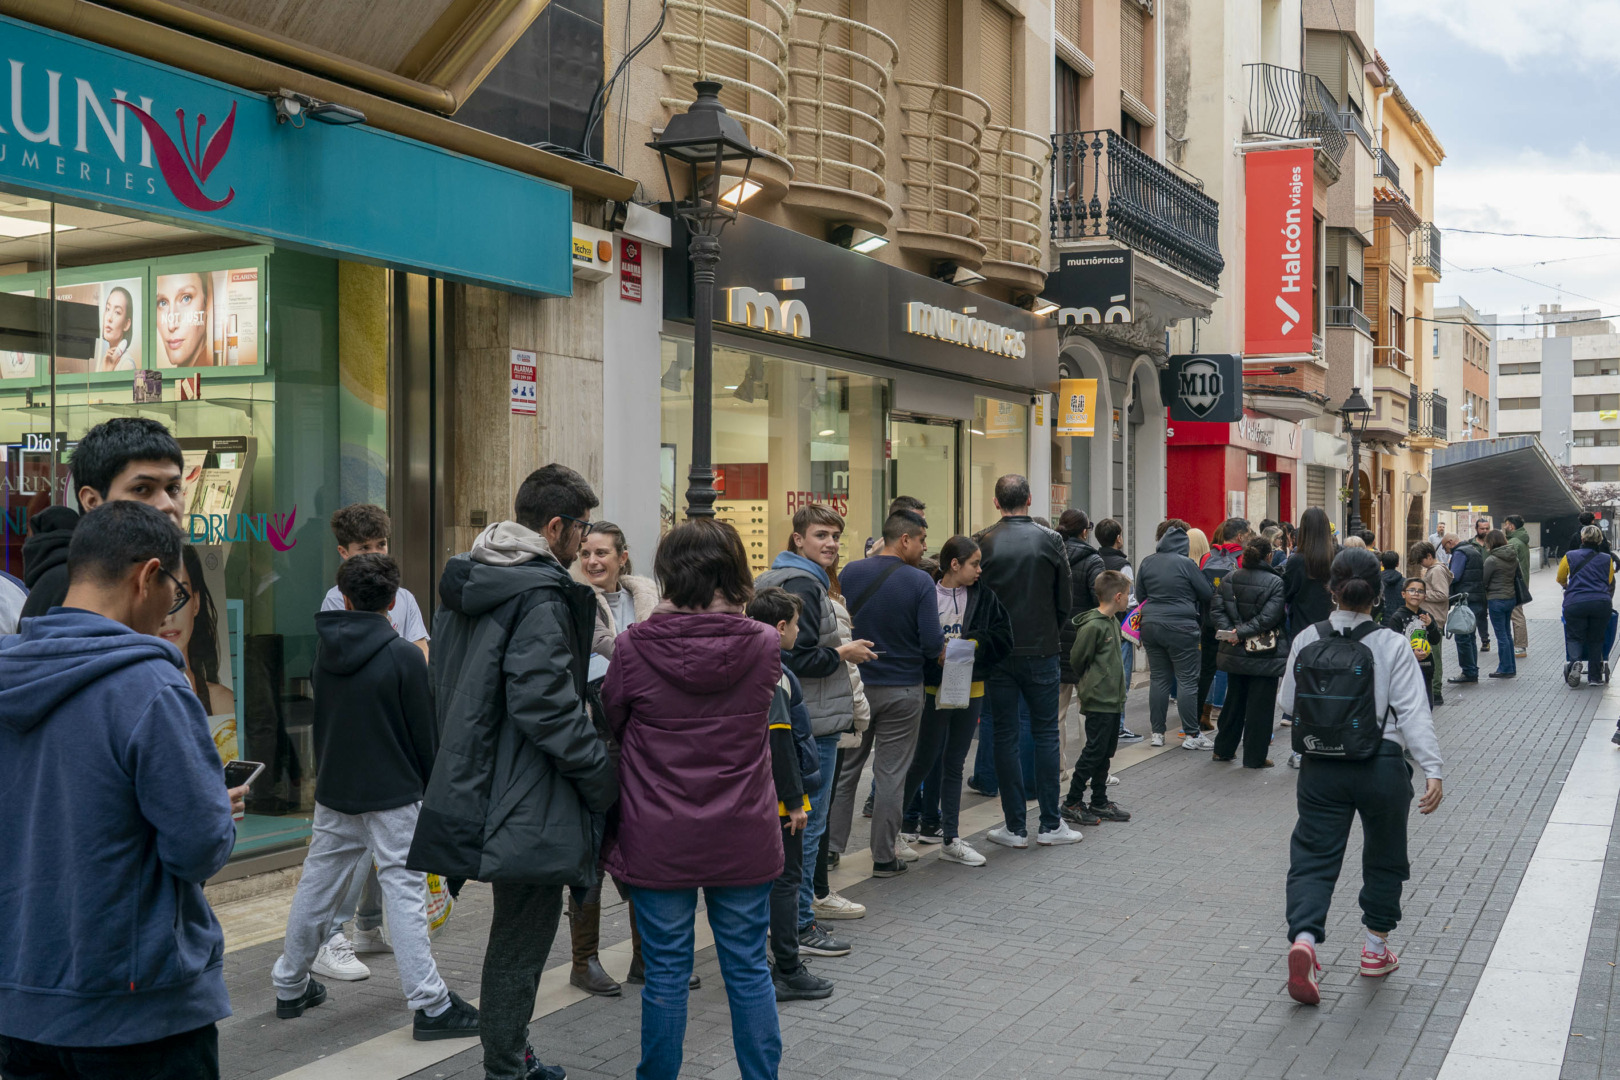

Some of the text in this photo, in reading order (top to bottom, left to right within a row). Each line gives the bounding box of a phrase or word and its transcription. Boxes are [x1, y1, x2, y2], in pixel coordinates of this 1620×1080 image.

[0, 58, 154, 169] UNI
[1281, 166, 1303, 293] Halcón viajes
[232, 273, 258, 281] CLARINS
[514, 364, 533, 374] ALARMA
[1180, 373, 1220, 396] M10
[26, 433, 60, 452] Dior
[190, 512, 268, 543] DRUNI
